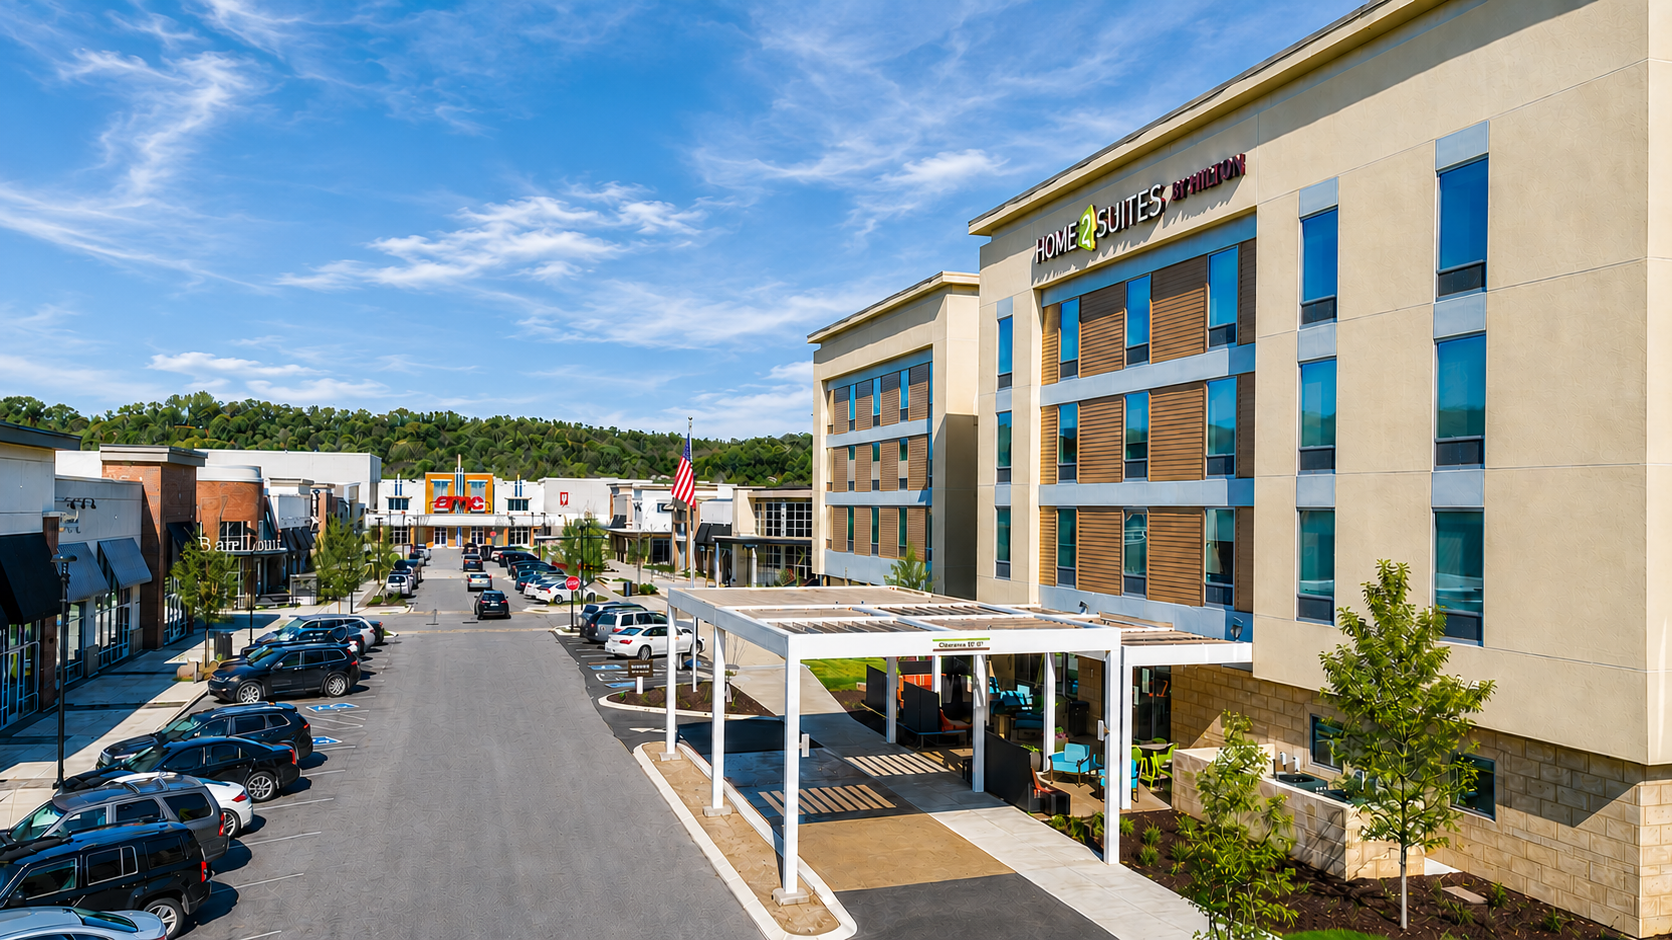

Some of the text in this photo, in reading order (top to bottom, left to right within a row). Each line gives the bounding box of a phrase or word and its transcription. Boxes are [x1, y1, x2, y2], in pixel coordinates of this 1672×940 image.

[1035, 153, 1246, 264] HOME 2 SUITES BY HILTON
